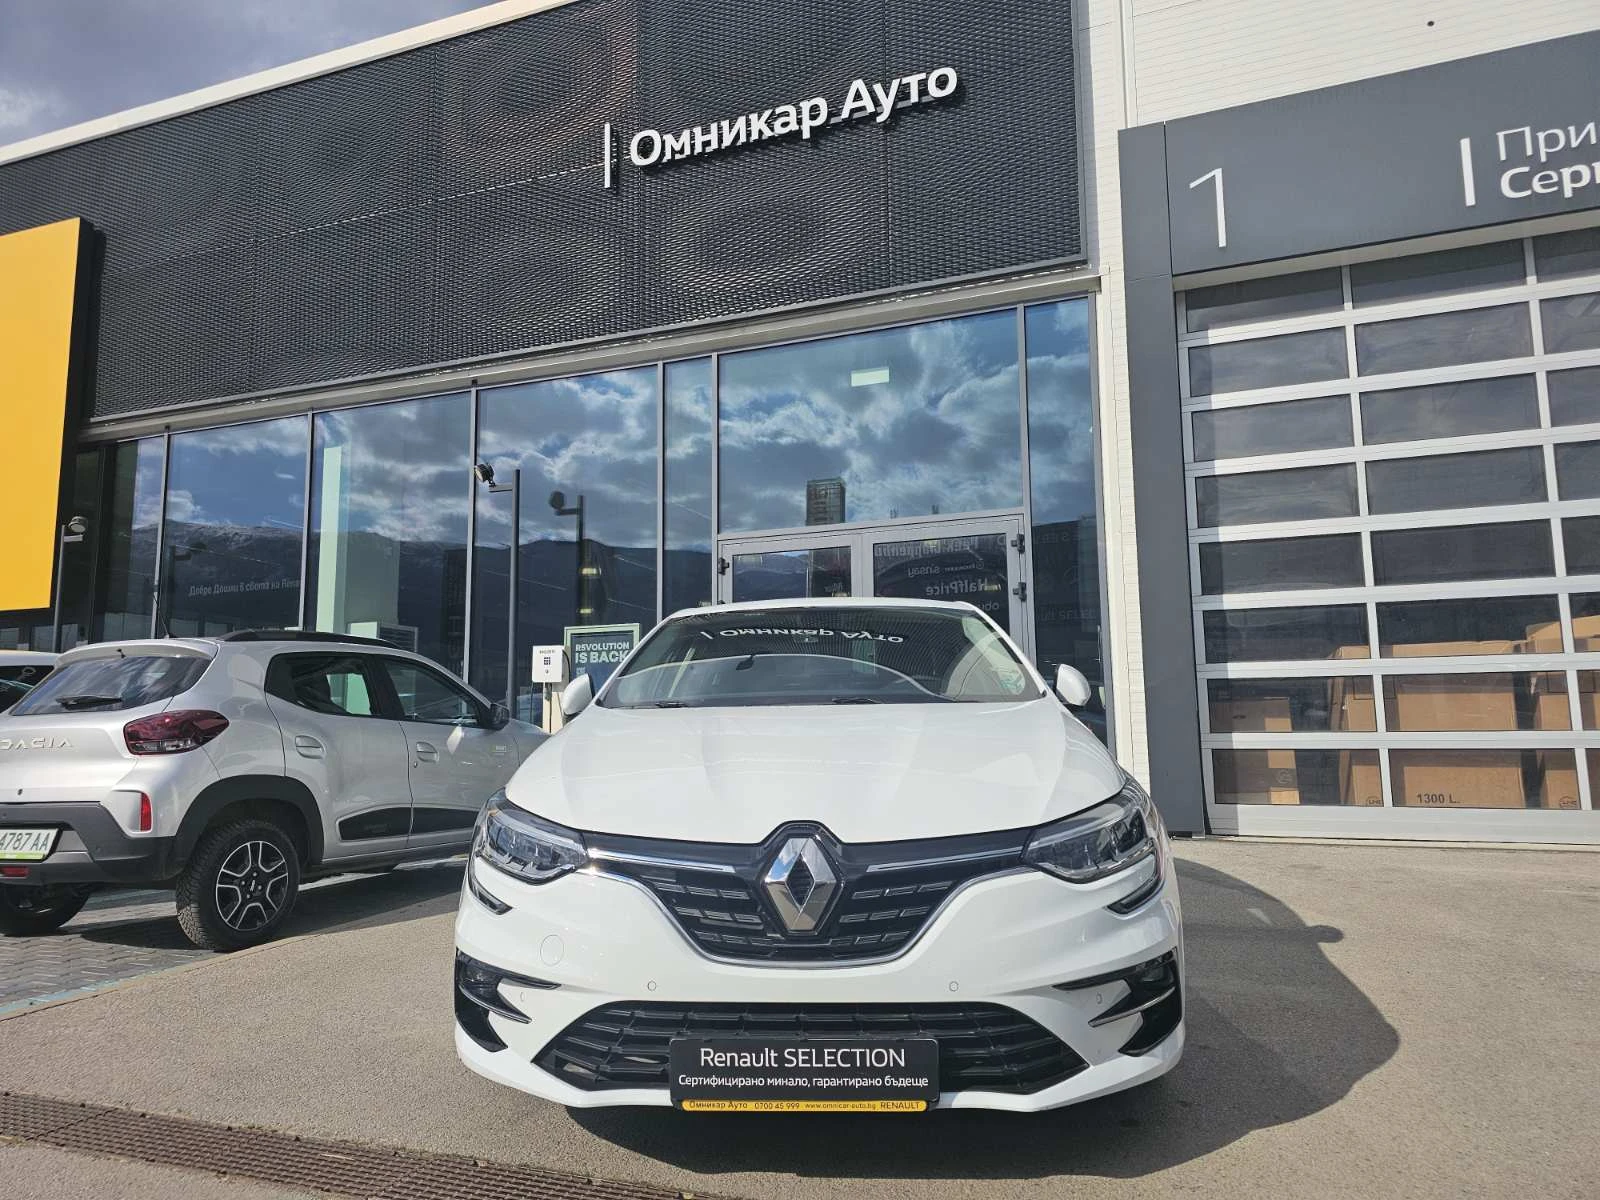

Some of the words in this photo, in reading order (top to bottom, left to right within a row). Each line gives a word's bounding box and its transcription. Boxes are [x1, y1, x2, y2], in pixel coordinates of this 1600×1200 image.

[629, 96, 828, 166] Омникар
[841, 67, 957, 123] Ауто
[1496, 121, 1597, 162] При
[1189, 167, 1227, 248] 1
[575, 652, 588, 663] IS
[590, 650, 629, 663] BACK
[1416, 794, 1446, 804] 1300
[30, 832, 51, 850] AA
[700, 1047, 778, 1067] Renault
[784, 1048, 905, 1068] SELECTION
[678, 1074, 765, 1087] Сертифицирано
[767, 1076, 811, 1087] минало,
[812, 1077, 882, 1087] гарантирано
[884, 1075, 929, 1087] бъдеще
[728, 1101, 748, 1110] Ауто
[754, 1102, 773, 1110] 0700
[775, 1102, 784, 1110] 45
[786, 1102, 800, 1110] 999
[880, 1101, 920, 1109] RENAULT
